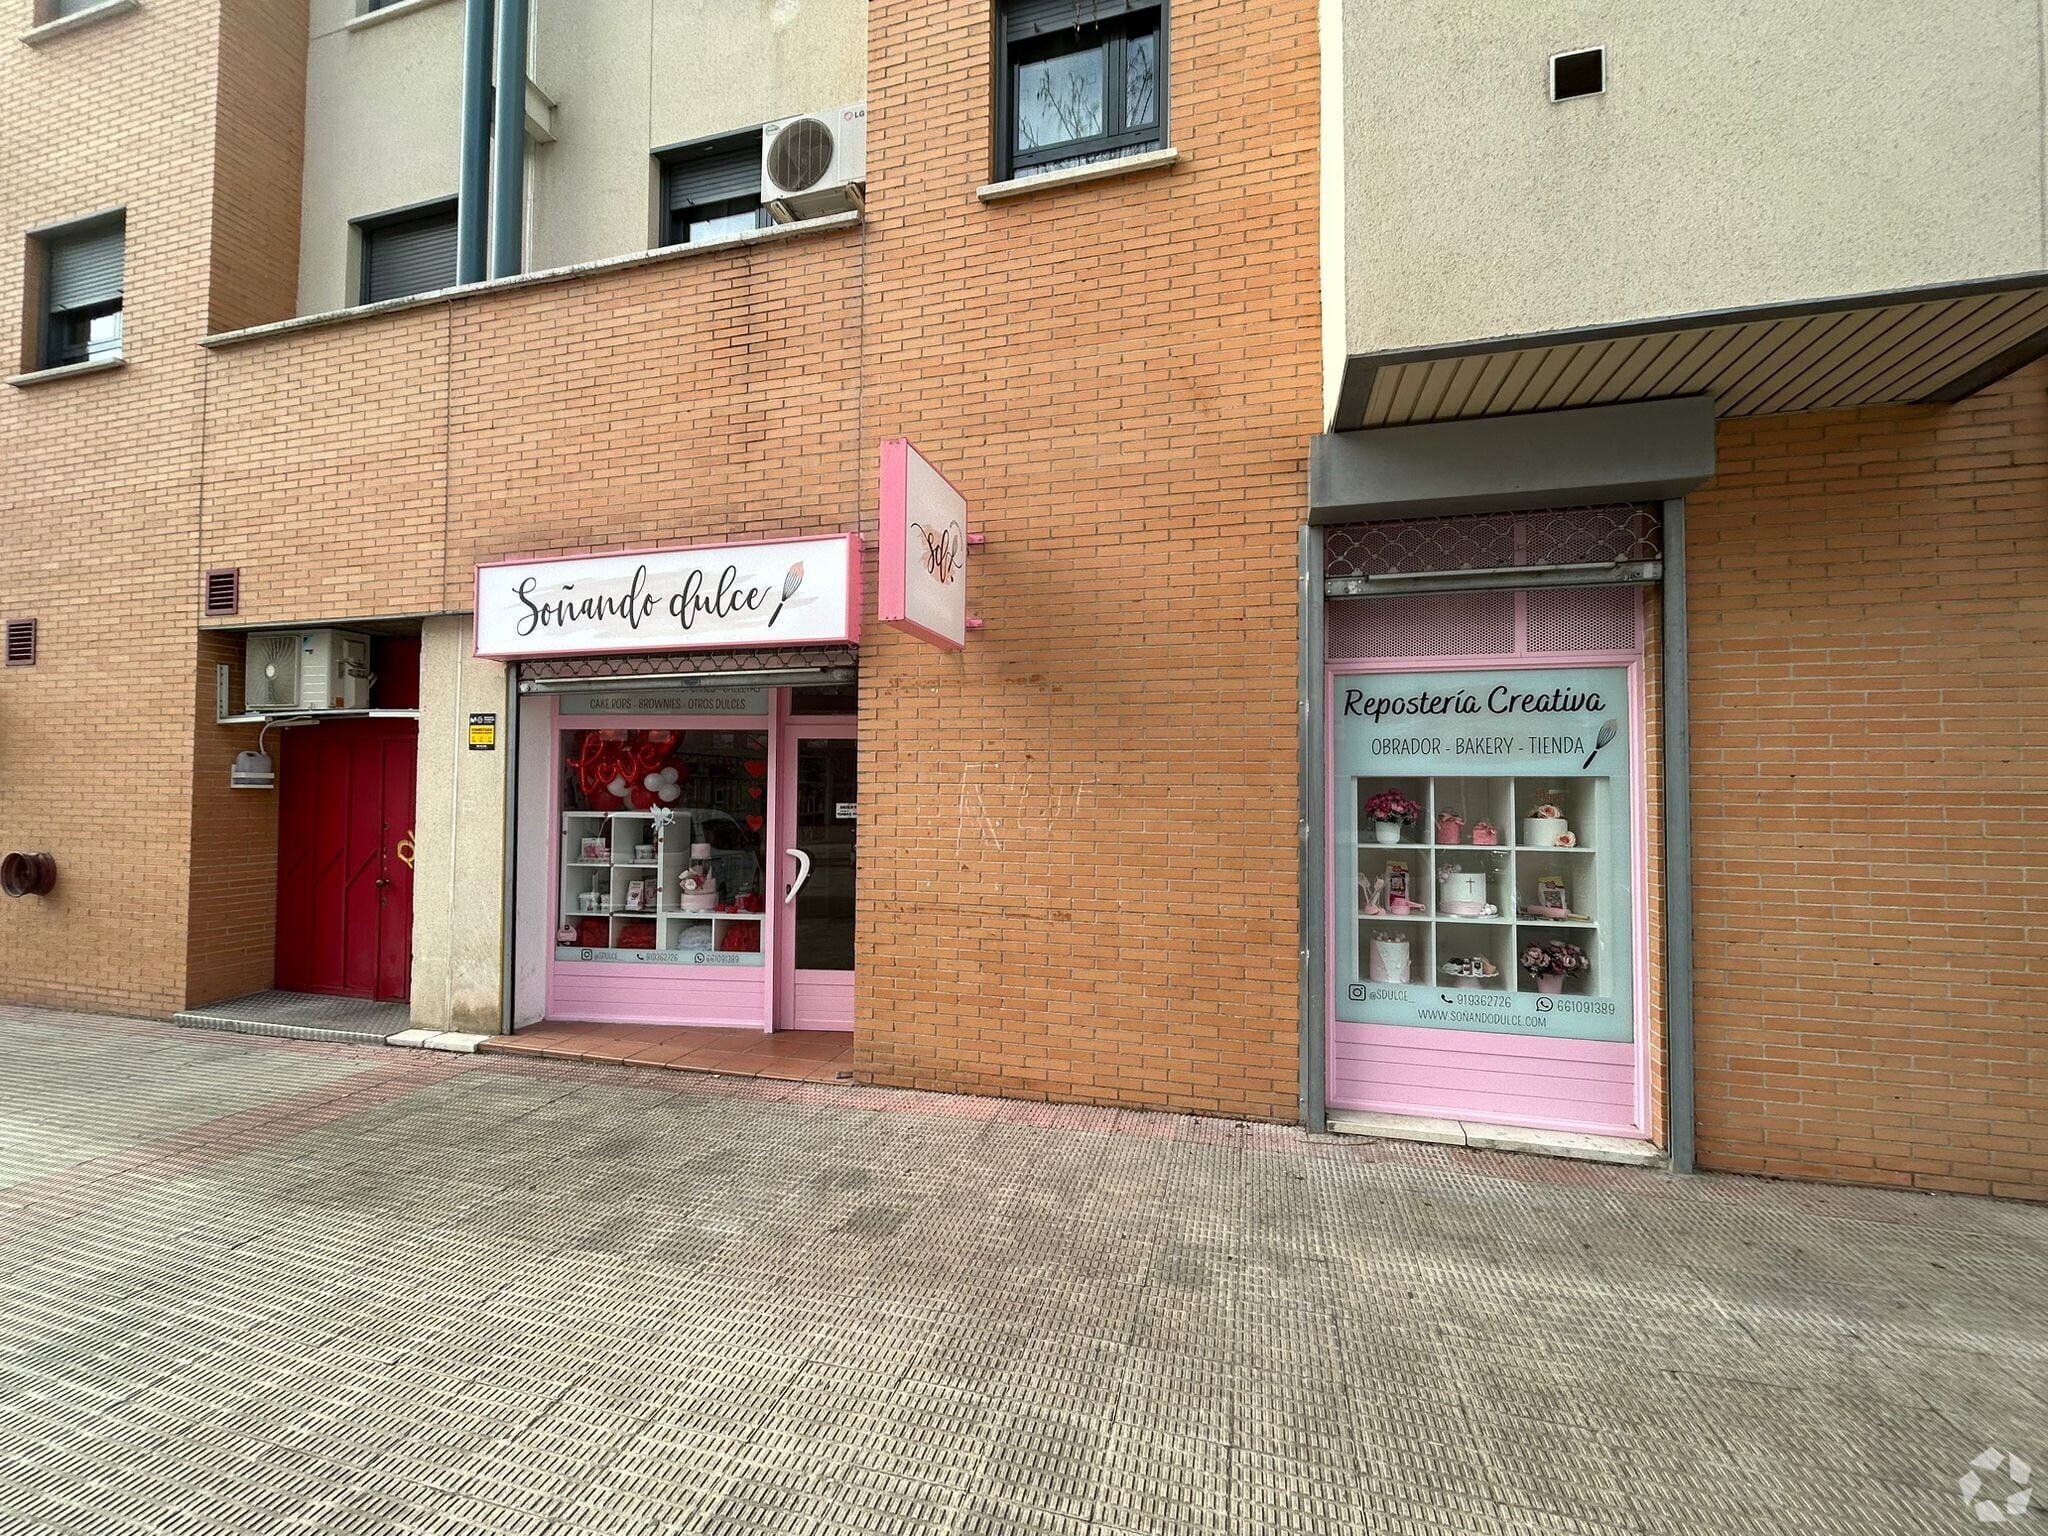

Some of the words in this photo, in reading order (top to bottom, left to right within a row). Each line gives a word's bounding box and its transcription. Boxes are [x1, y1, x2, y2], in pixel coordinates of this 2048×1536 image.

[854, 110, 865, 119] LG
[511, 564, 663, 637] Soñando
[668, 564, 772, 631] dulce
[589, 698, 610, 710] CAKE
[611, 698, 632, 710] POPS
[638, 698, 681, 710] BROWNIES
[687, 698, 714, 710] OTROS
[715, 698, 746, 710] DULCES
[1344, 688, 1482, 724] Repostería
[1487, 685, 1606, 715] Creativa
[1371, 736, 1441, 756] OBRADOR
[1455, 736, 1514, 755] BAKERY
[1528, 736, 1585, 755] TIENDA
[1456, 993, 1512, 1009] 919362726
[1557, 1000, 1616, 1016] 661091389
[1417, 1008, 1548, 1028] WWW.SOÑANDODULCE.COM
